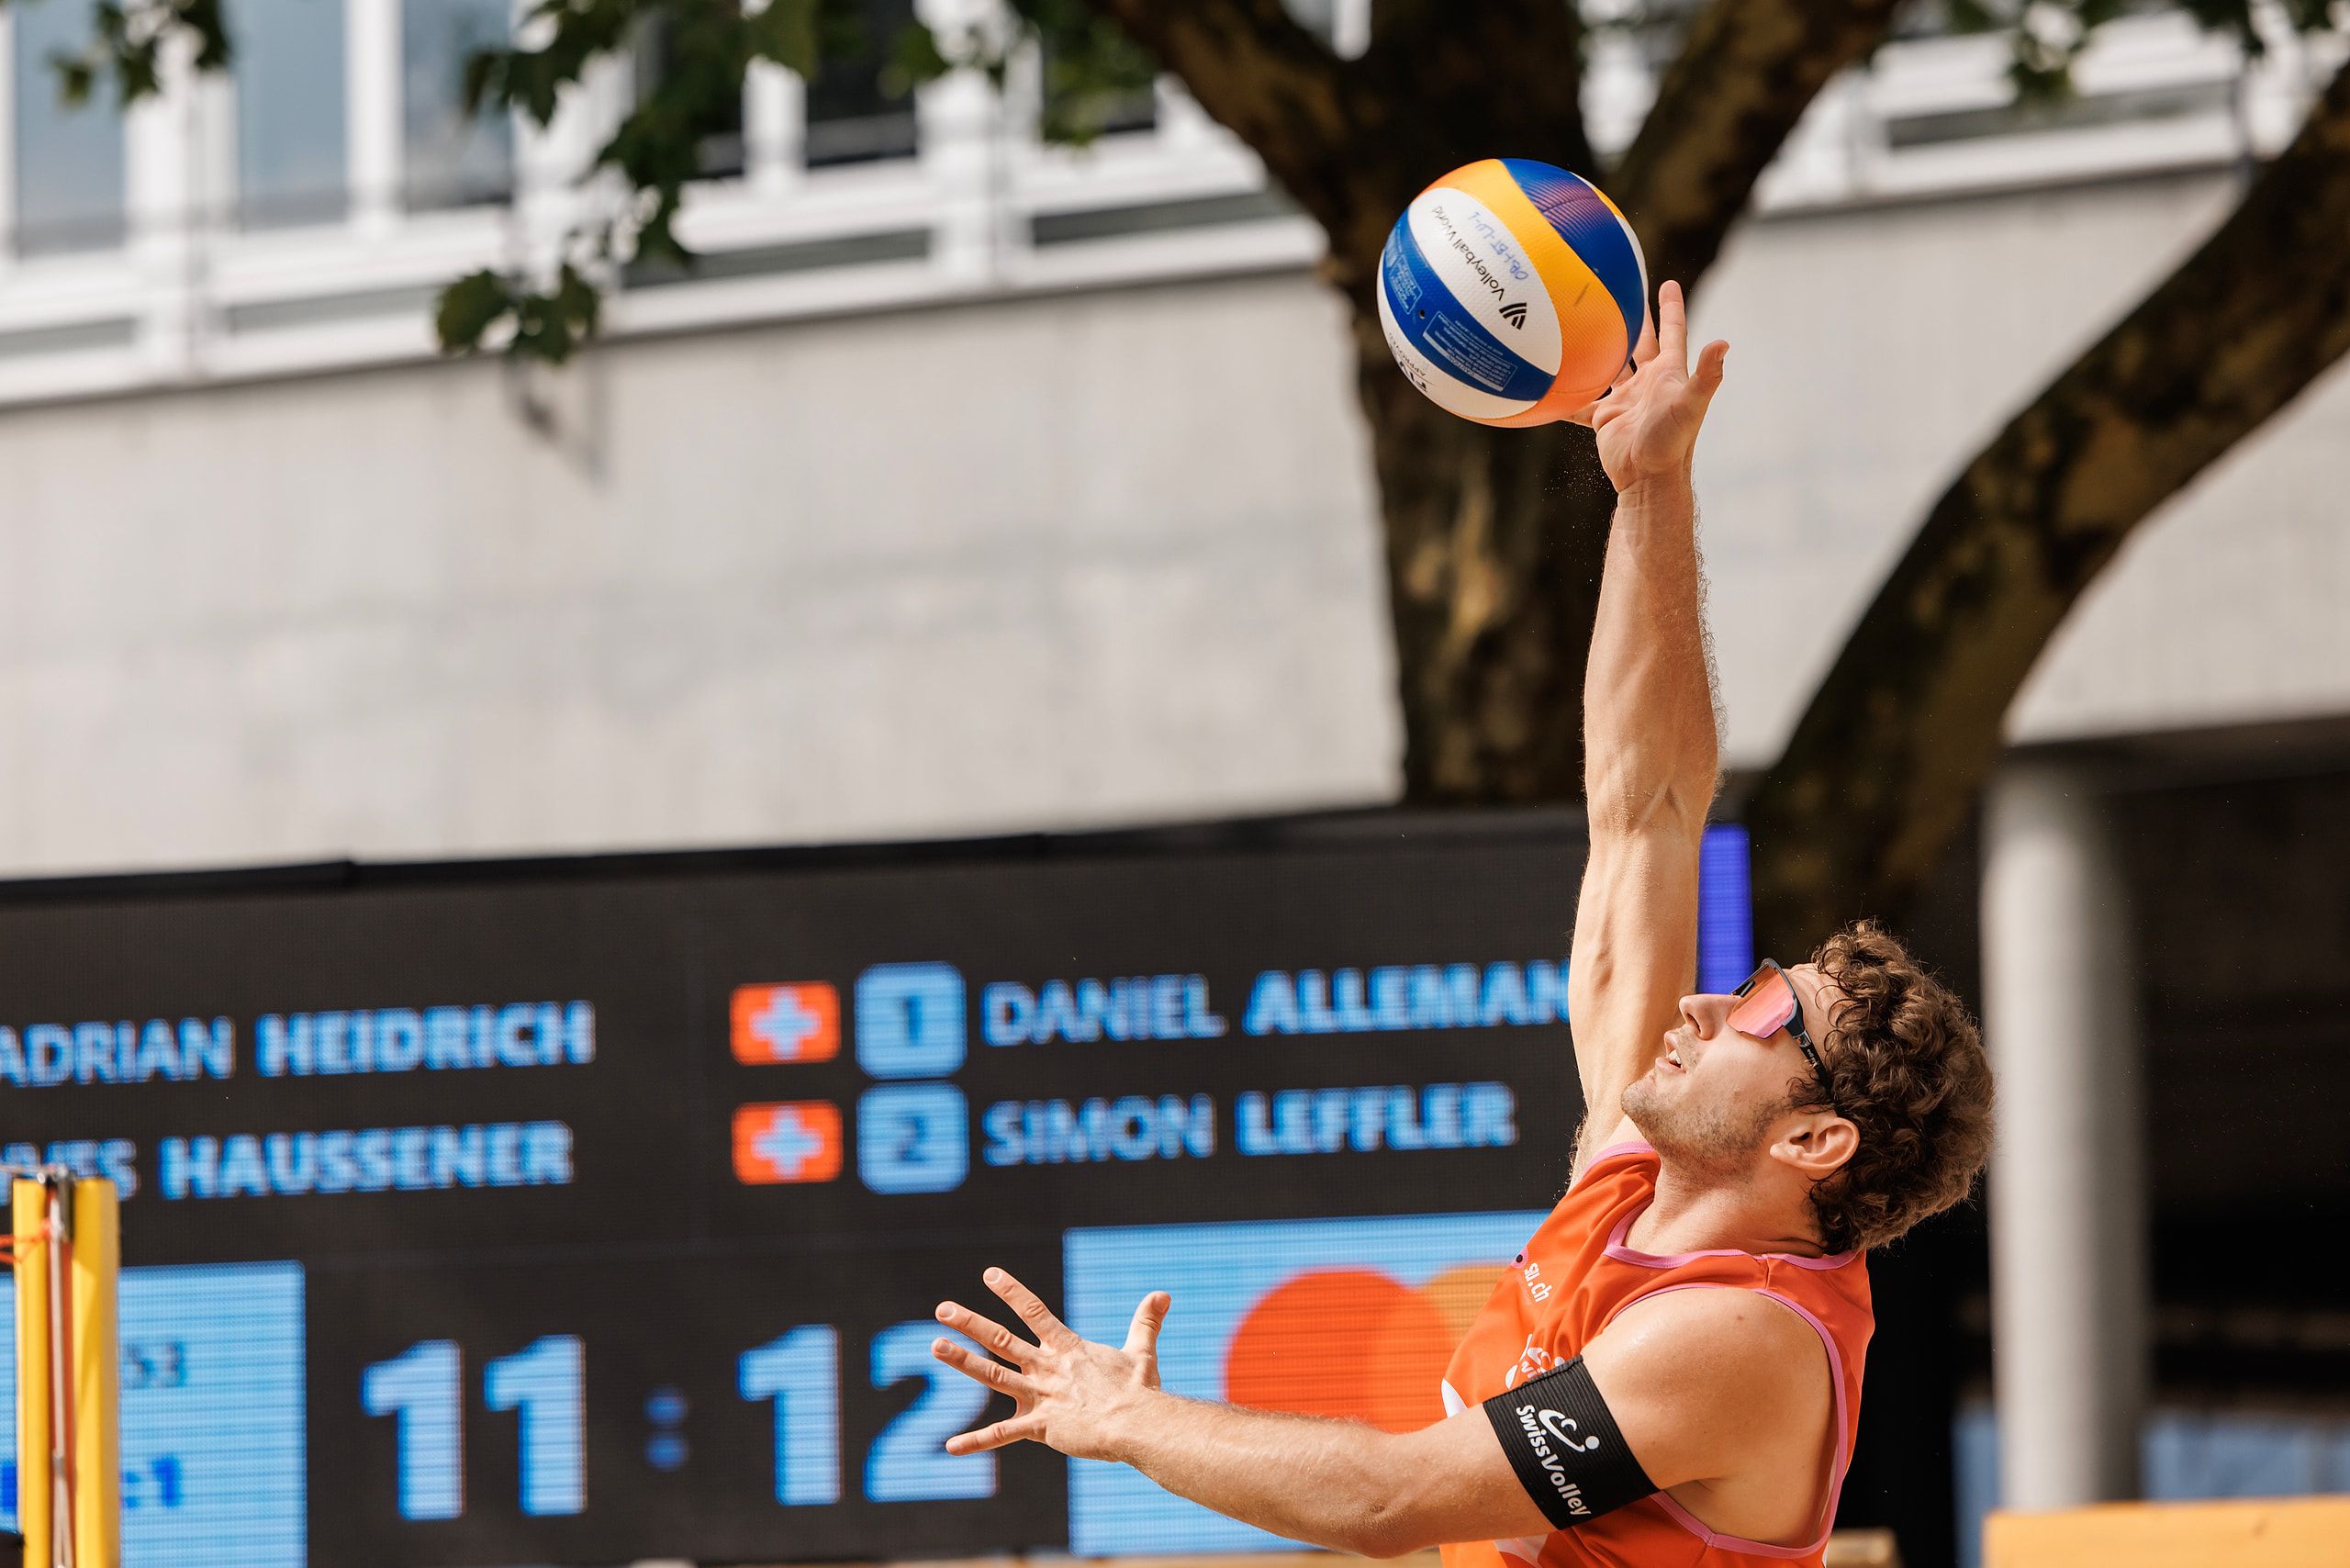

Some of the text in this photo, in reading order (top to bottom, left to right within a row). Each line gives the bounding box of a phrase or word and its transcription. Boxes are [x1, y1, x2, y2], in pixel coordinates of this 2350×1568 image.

[1431, 206, 1458, 241] World
[1452, 238, 1505, 302] Volleyball
[255, 1000, 596, 1078] HEIDRICH
[980, 973, 1229, 1047] DANIEL
[158, 1119, 574, 1201] HAUSSENER
[981, 1092, 1217, 1167] SIMON
[1234, 1081, 1520, 1156] LEFFLER
[737, 1319, 1000, 1508] 12
